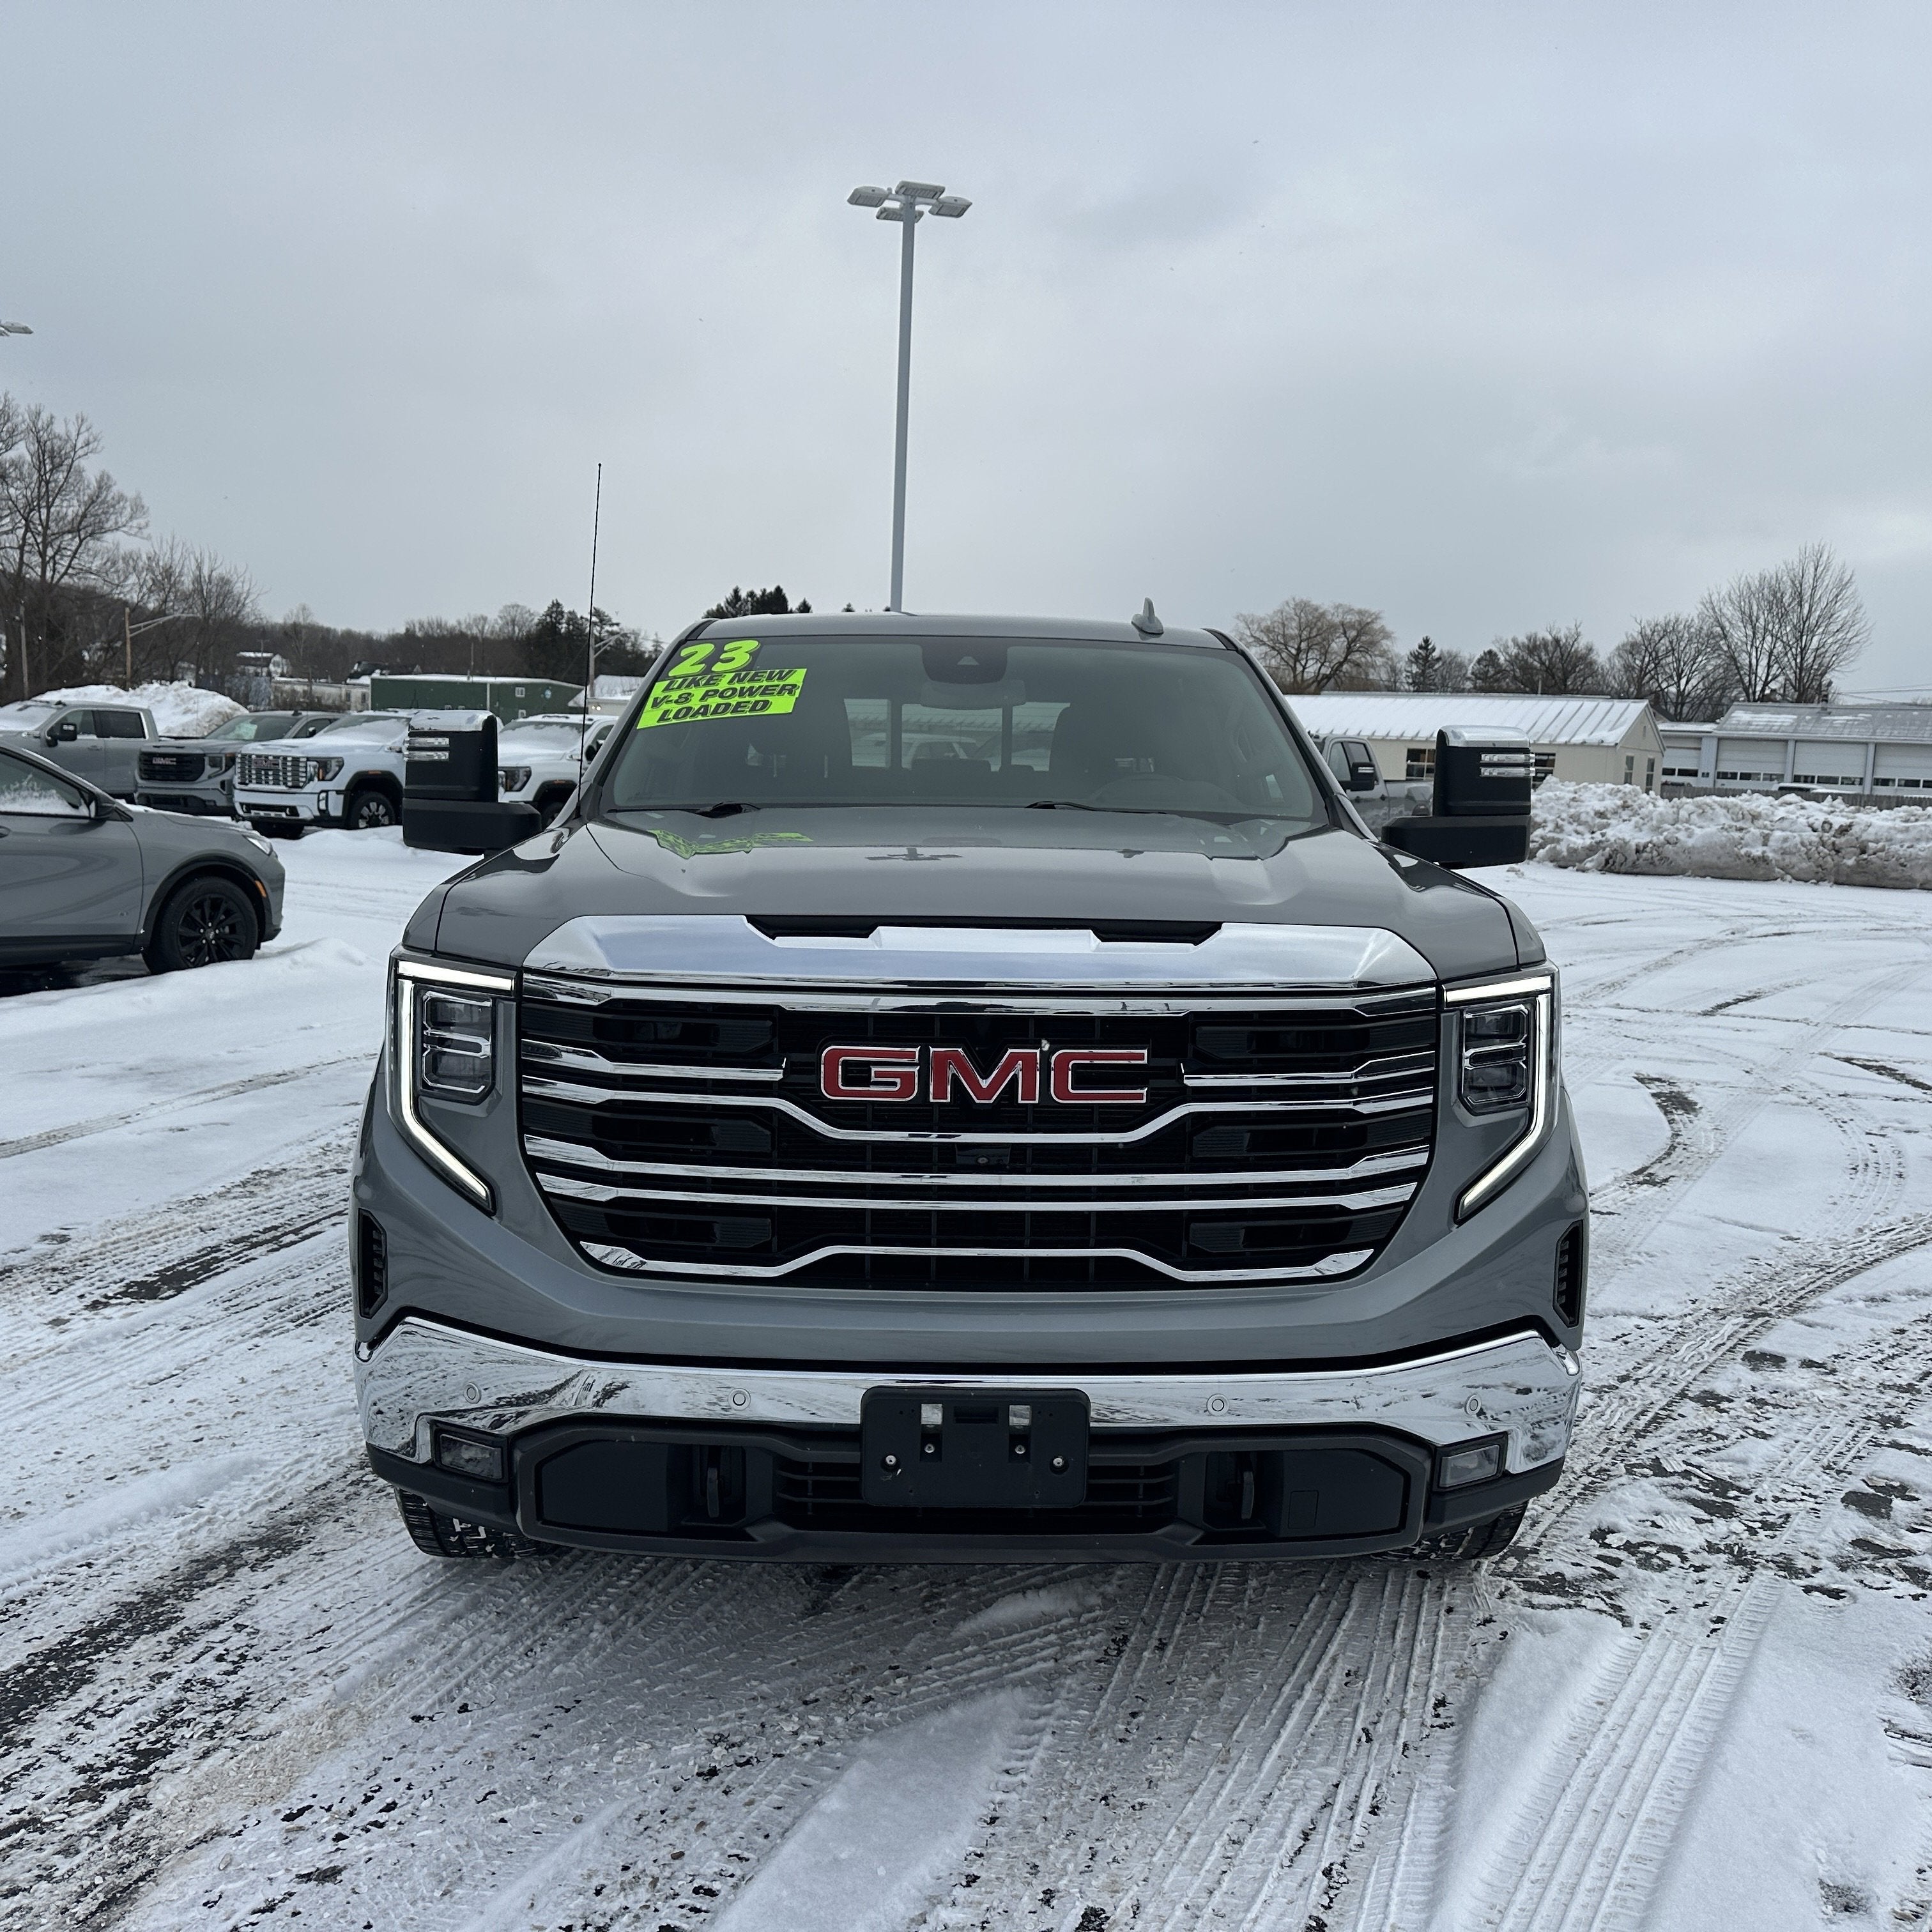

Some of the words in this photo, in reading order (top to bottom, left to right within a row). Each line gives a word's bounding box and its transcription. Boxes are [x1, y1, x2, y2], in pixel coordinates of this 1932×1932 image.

[668, 640, 761, 677] 23
[663, 673, 726, 693] LIKE
[727, 669, 799, 686] NEW
[650, 692, 694, 709] V-8
[699, 683, 800, 703] POWER
[656, 699, 772, 724] LOADED
[820, 1045, 1149, 1104] GMC
